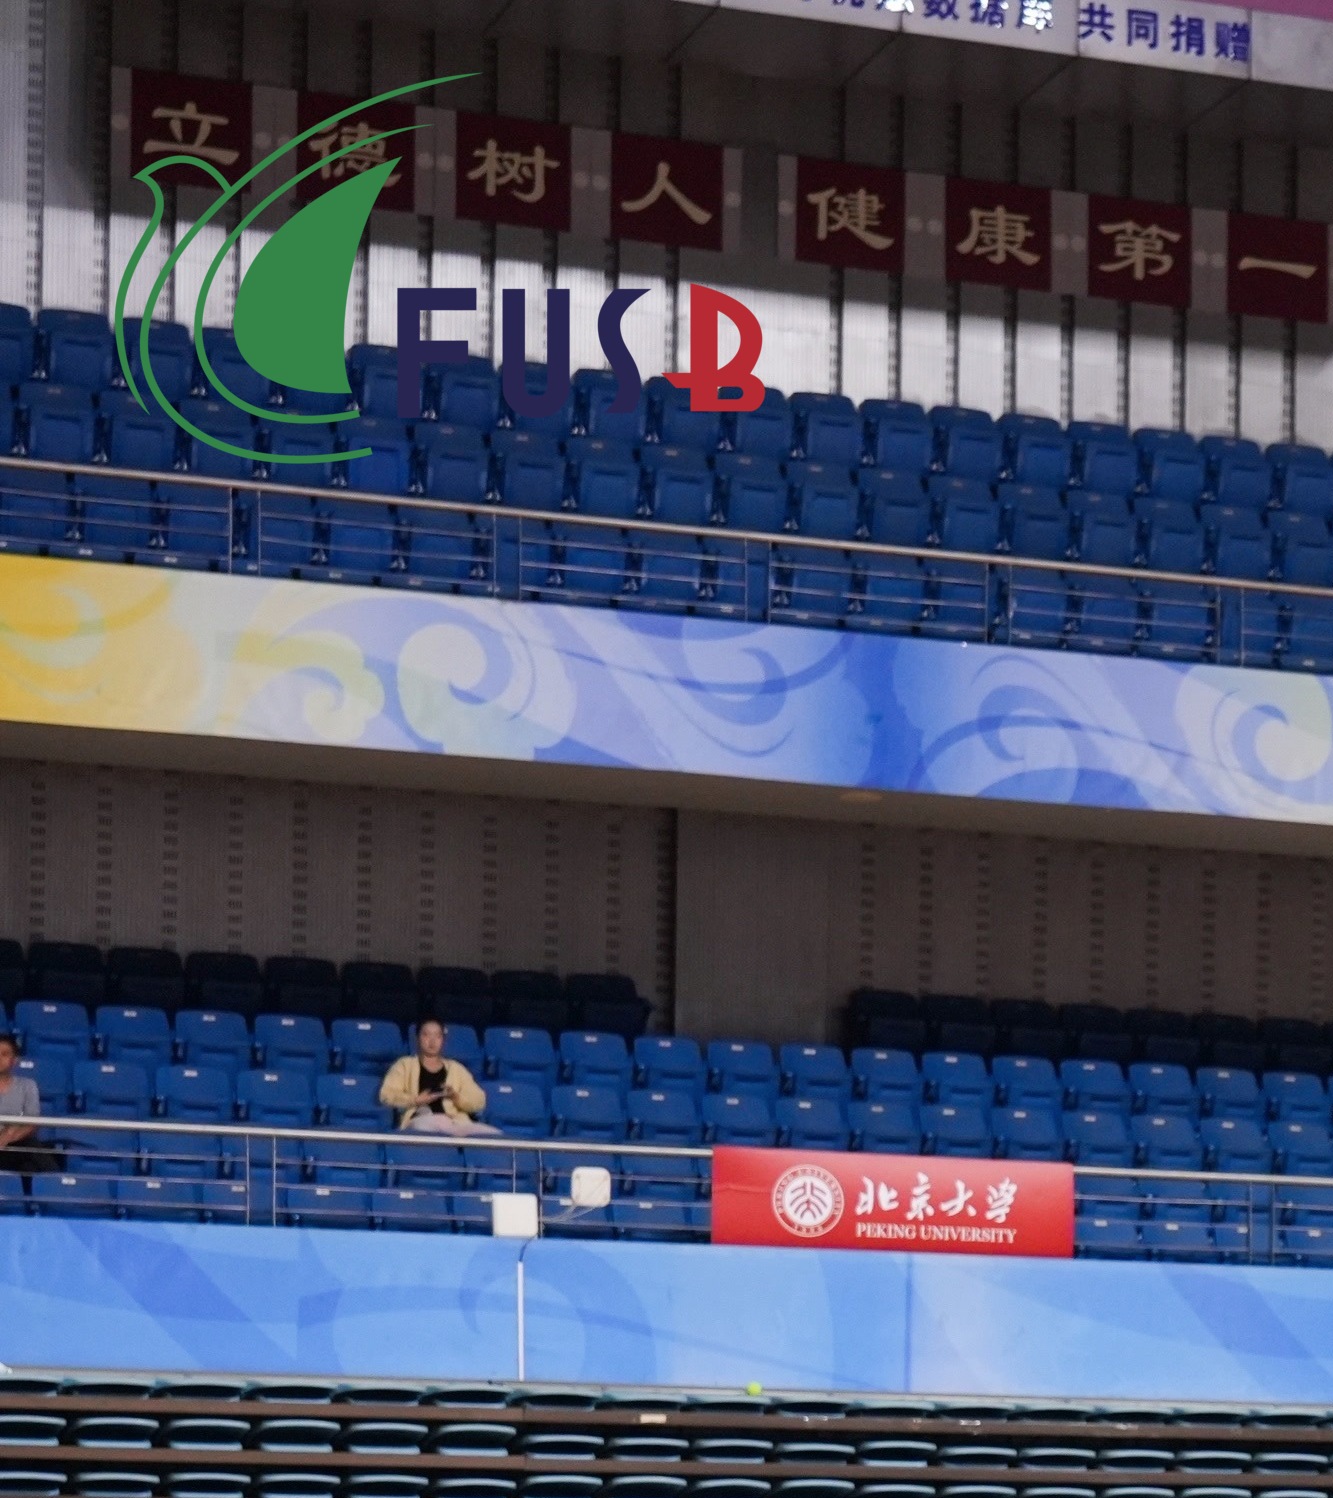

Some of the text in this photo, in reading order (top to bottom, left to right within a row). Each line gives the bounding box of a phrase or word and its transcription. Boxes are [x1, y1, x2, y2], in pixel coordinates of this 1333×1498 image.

[1078, 2, 1250, 62] 共同捐赠
[142, 101, 1318, 281] 立德树人 健康第一
[855, 1171, 1018, 1224] 北京大学
[856, 1222, 1018, 1244] PEKING UNIVERSITY
